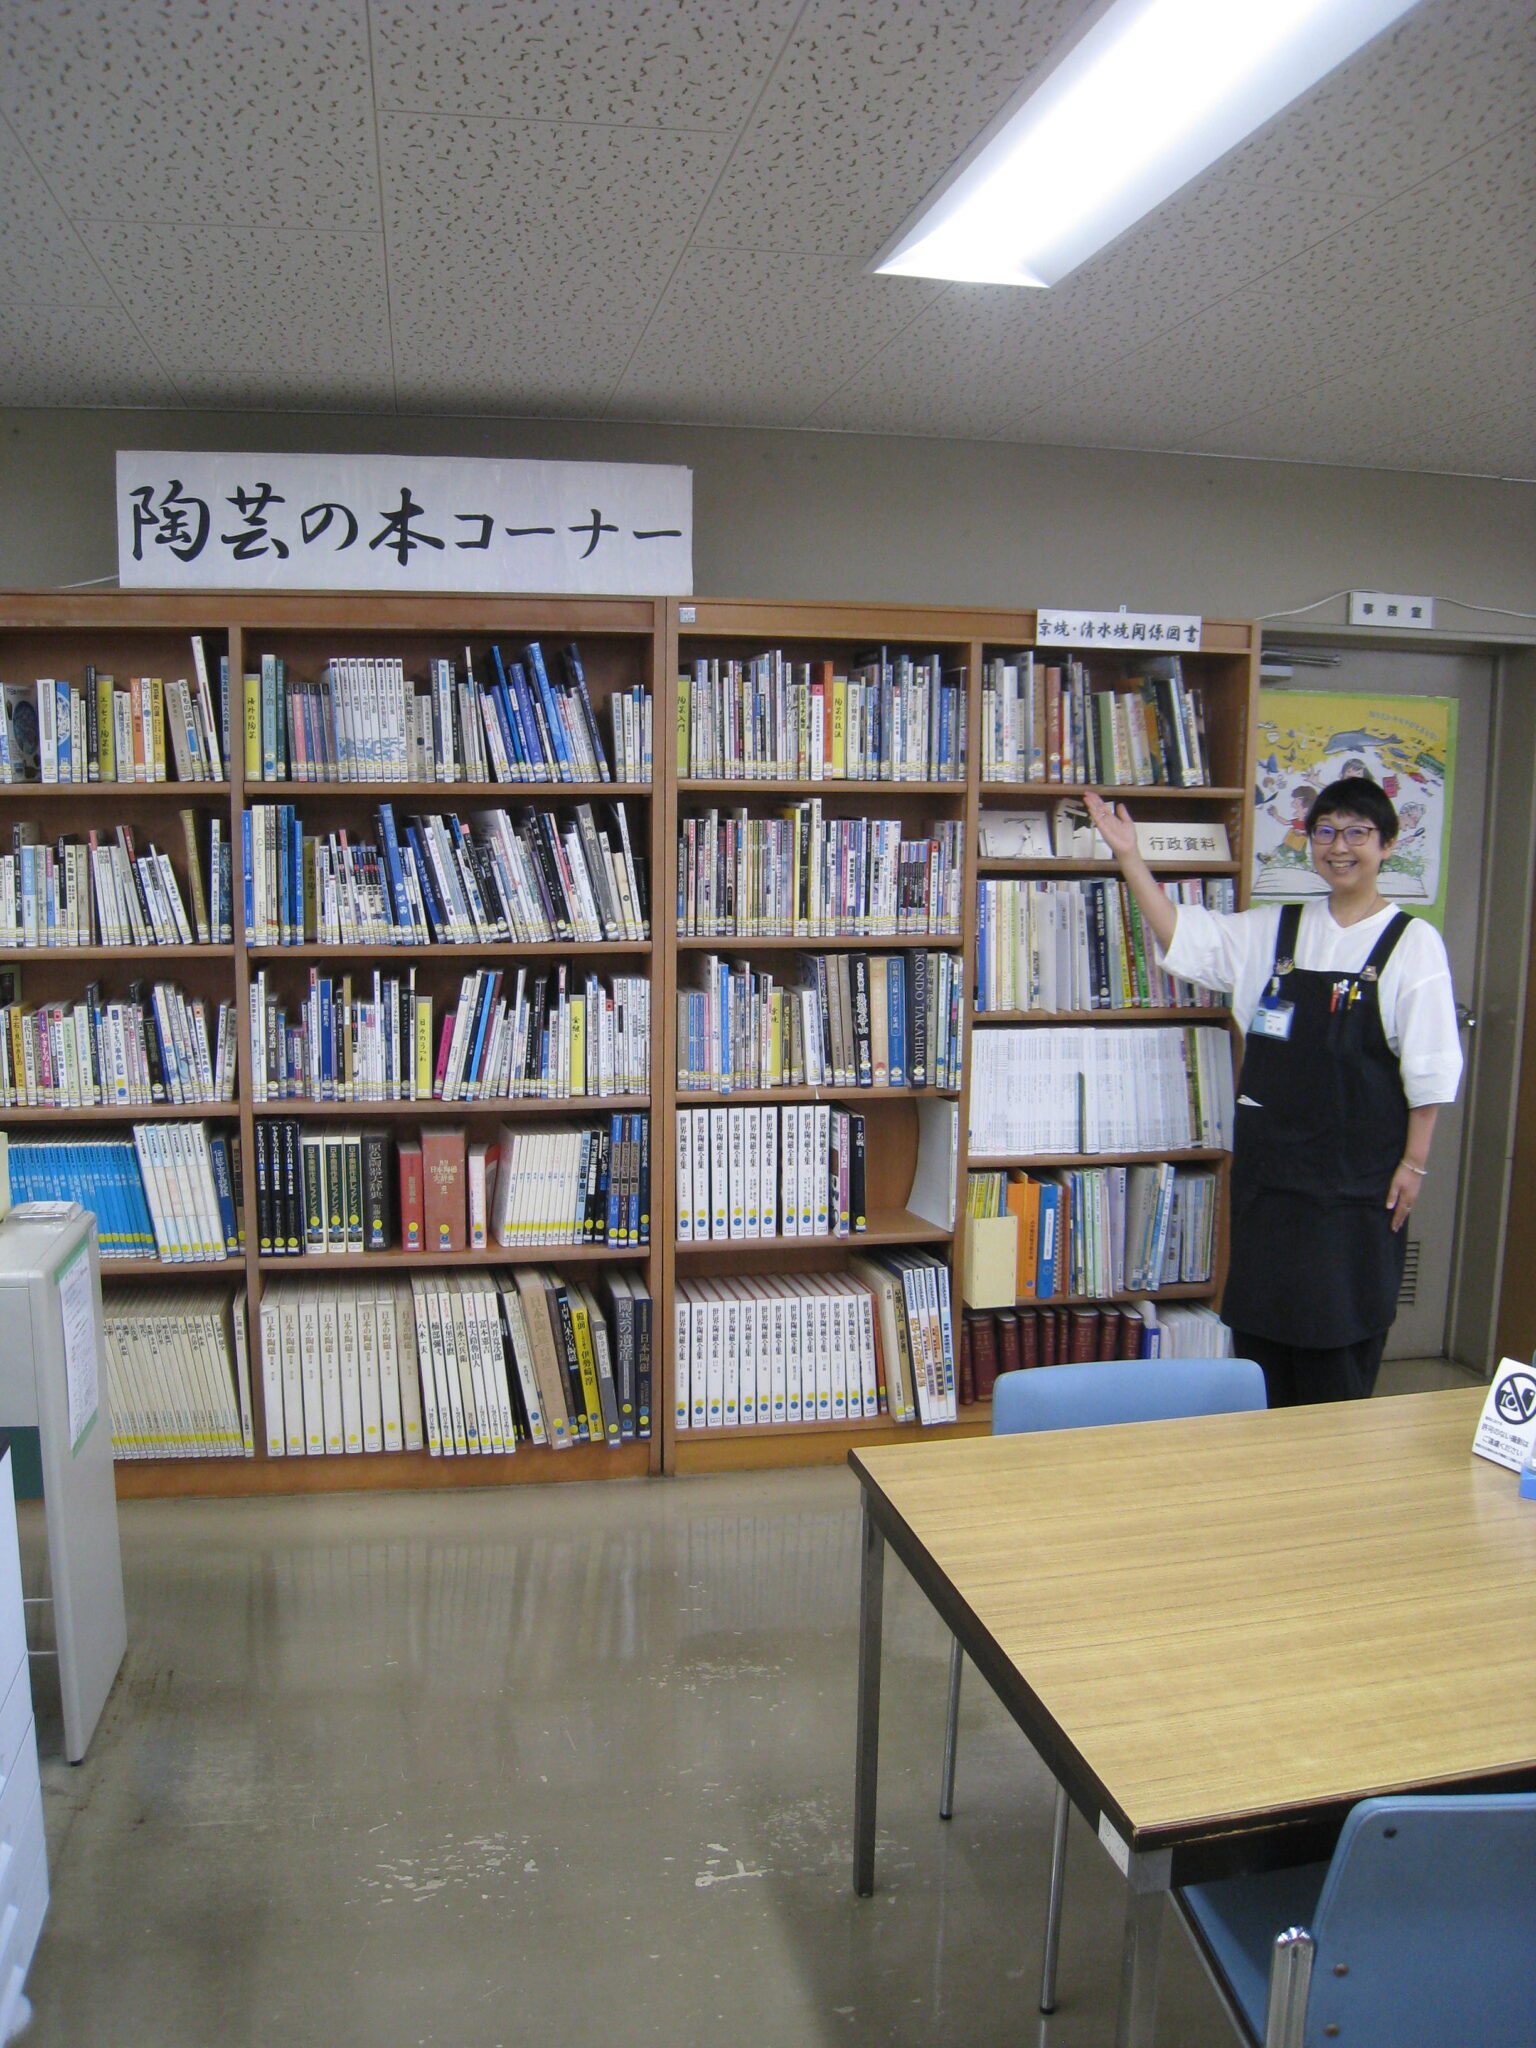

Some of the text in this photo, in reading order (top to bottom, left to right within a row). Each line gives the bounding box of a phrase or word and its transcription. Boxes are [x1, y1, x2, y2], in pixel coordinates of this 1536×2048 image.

[129, 480, 683, 567] 陶芸の本コーナー
[1363, 603, 1422, 618] 事務室
[1038, 618, 1200, 644] 京焼・清水焼関係図書
[247, 698, 256, 739] 海外の陶芸
[678, 696, 686, 732] 陶芸入門
[835, 699, 843, 738] 陶芸の技法
[1149, 836, 1216, 852] 行政資料
[915, 954, 924, 1067] KONDO TAKAHIRO
[266, 1316, 276, 1355] 日本の陶磁
[285, 1316, 295, 1354] 日本の陶磁
[305, 1315, 314, 1353] 日本の陶磁
[324, 1313, 333, 1353] 日本の陶磁
[344, 1313, 353, 1352] 日本の陶磁
[363, 1312, 372, 1351] 日本の陶磁
[382, 1312, 392, 1350] 日本の陶磁
[418, 1323, 428, 1354] 八木一夫
[479, 1320, 490, 1354] 富本憲吉
[490, 1321, 502, 1361] 河井寛次郎
[576, 1313, 585, 1330] 備前
[619, 1301, 633, 1360] 陶芸の遺産
[863, 1301, 871, 1350] 世界陶磁全集
[468, 1321, 480, 1367] 北大路魯山人
[639, 1334, 649, 1372] 日本陶磁
